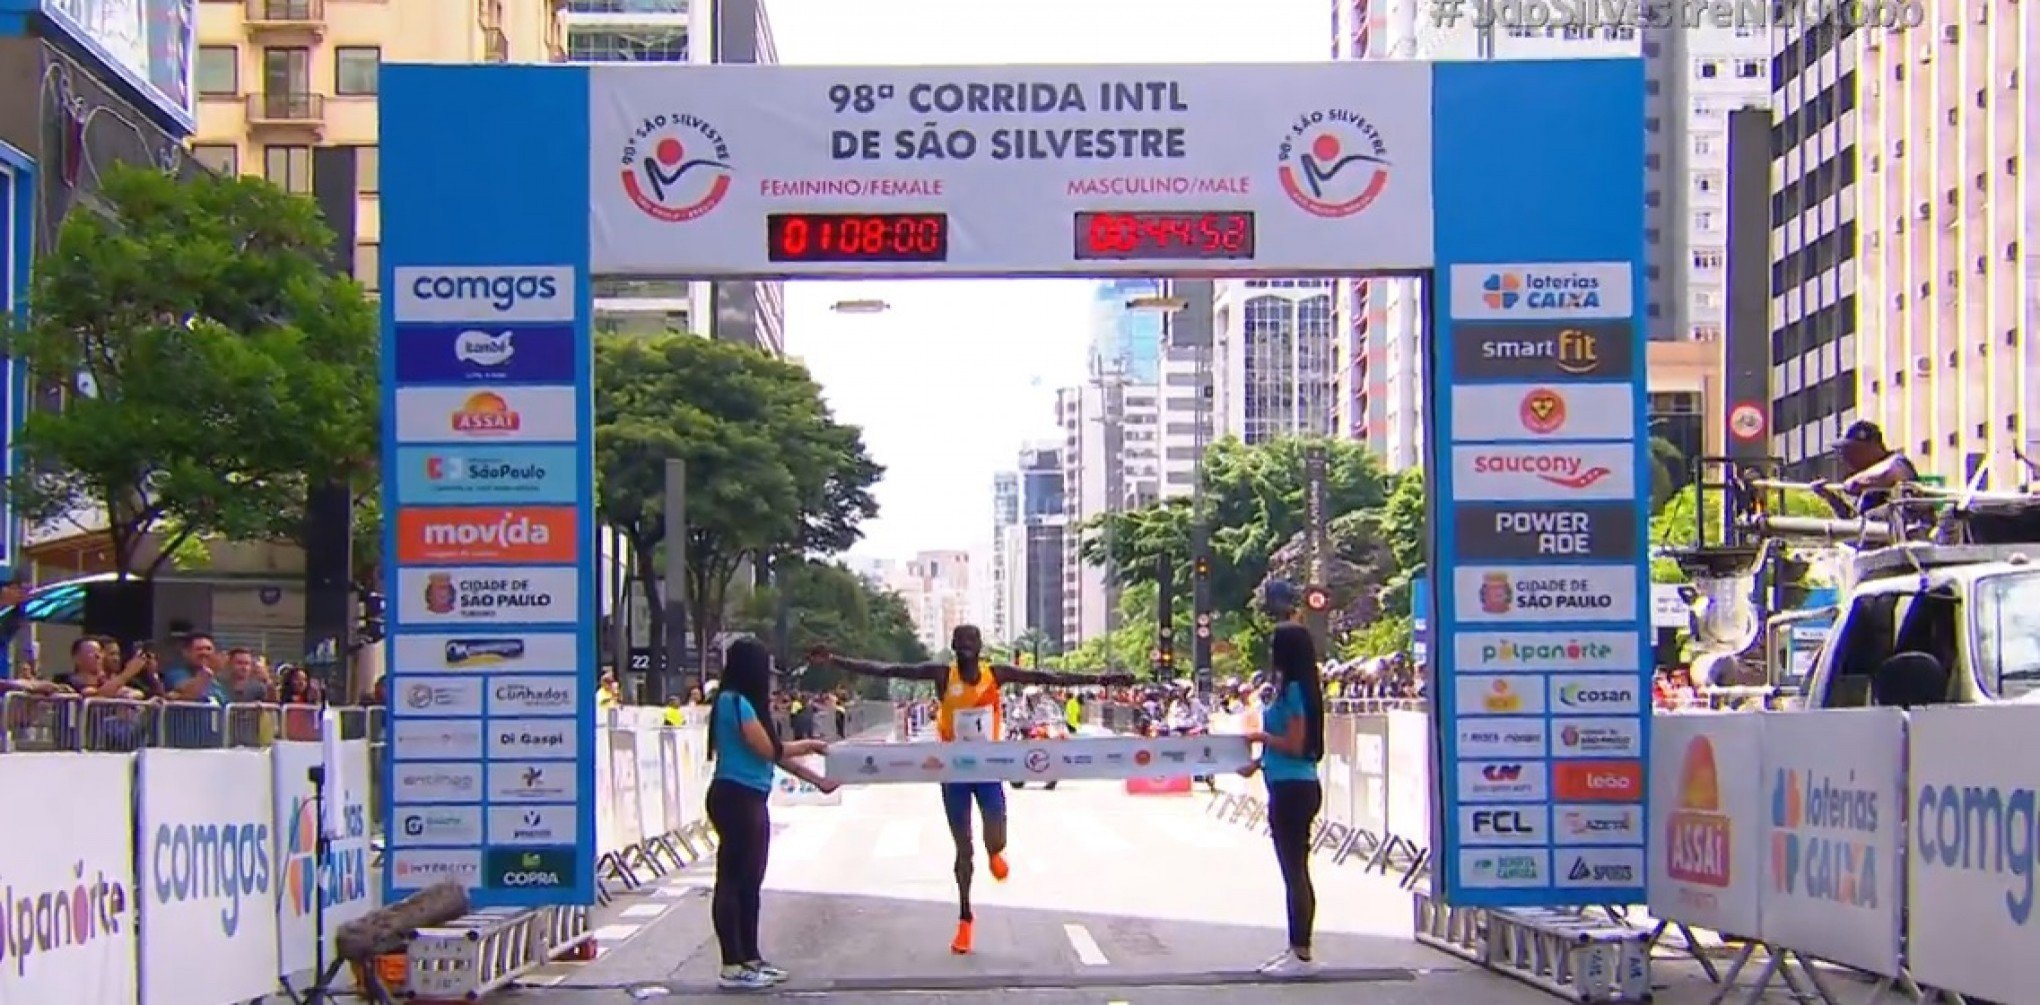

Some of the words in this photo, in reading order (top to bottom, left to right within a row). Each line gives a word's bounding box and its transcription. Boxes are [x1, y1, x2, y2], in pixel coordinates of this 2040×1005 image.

[909, 83, 1087, 113] CORRIDA
[1100, 81, 1189, 112] INTL
[671, 112, 730, 160] SILVESTRE
[831, 131, 881, 160] DE
[894, 121, 977, 160] SÃO
[991, 128, 1186, 160] SILVESTRE
[1328, 108, 1387, 155] SILVESTRE
[760, 178, 943, 197] FEMININO/FEMALE
[1067, 176, 1250, 195] MASCULINO/MALE
[1526, 273, 1599, 289] loterias
[1526, 291, 1600, 308] CAIXA
[1482, 339, 1554, 358] smart
[1559, 329, 1597, 361] fit
[469, 464, 546, 479] SãoPaulo
[1474, 455, 1581, 474] saucony
[425, 512, 550, 547] movida
[1496, 512, 1590, 532] POWER
[1539, 534, 1591, 553] ADE
[460, 580, 507, 591] CIDADE
[511, 580, 527, 590] DE
[1516, 580, 1566, 592] CIDADE
[1571, 580, 1588, 592] DE
[460, 592, 493, 607] SÃO
[496, 594, 551, 607] PAULO
[1516, 593, 1550, 608] SÃO
[1556, 596, 1612, 608] PAULO
[1578, 690, 1632, 702] cosan
[501, 734, 515, 744] Di
[521, 734, 562, 747] Gaspi
[1806, 770, 1878, 832] loterias
[1473, 811, 1533, 833] FCL
[1918, 784, 2040, 925] comg
[503, 871, 559, 886] COPRA
[1806, 838, 1878, 908] CAIXA
